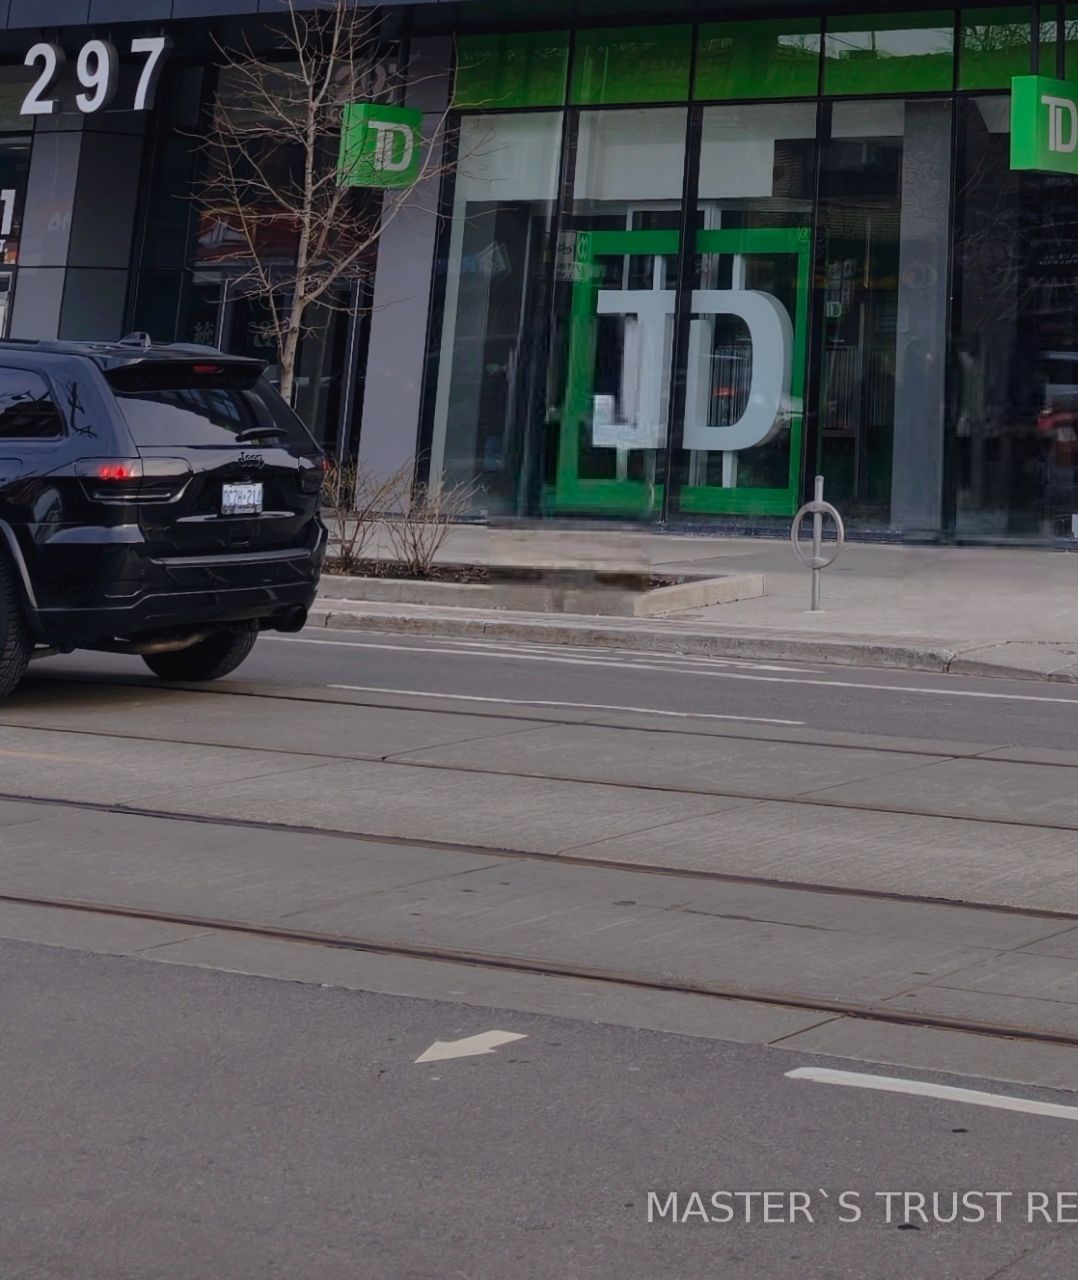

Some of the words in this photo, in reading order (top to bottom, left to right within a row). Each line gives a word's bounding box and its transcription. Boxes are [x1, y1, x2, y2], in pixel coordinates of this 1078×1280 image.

[20, 37, 166, 115] 297
[368, 120, 414, 172] TD
[1041, 95, 1078, 153] TD
[591, 289, 795, 451] TD
